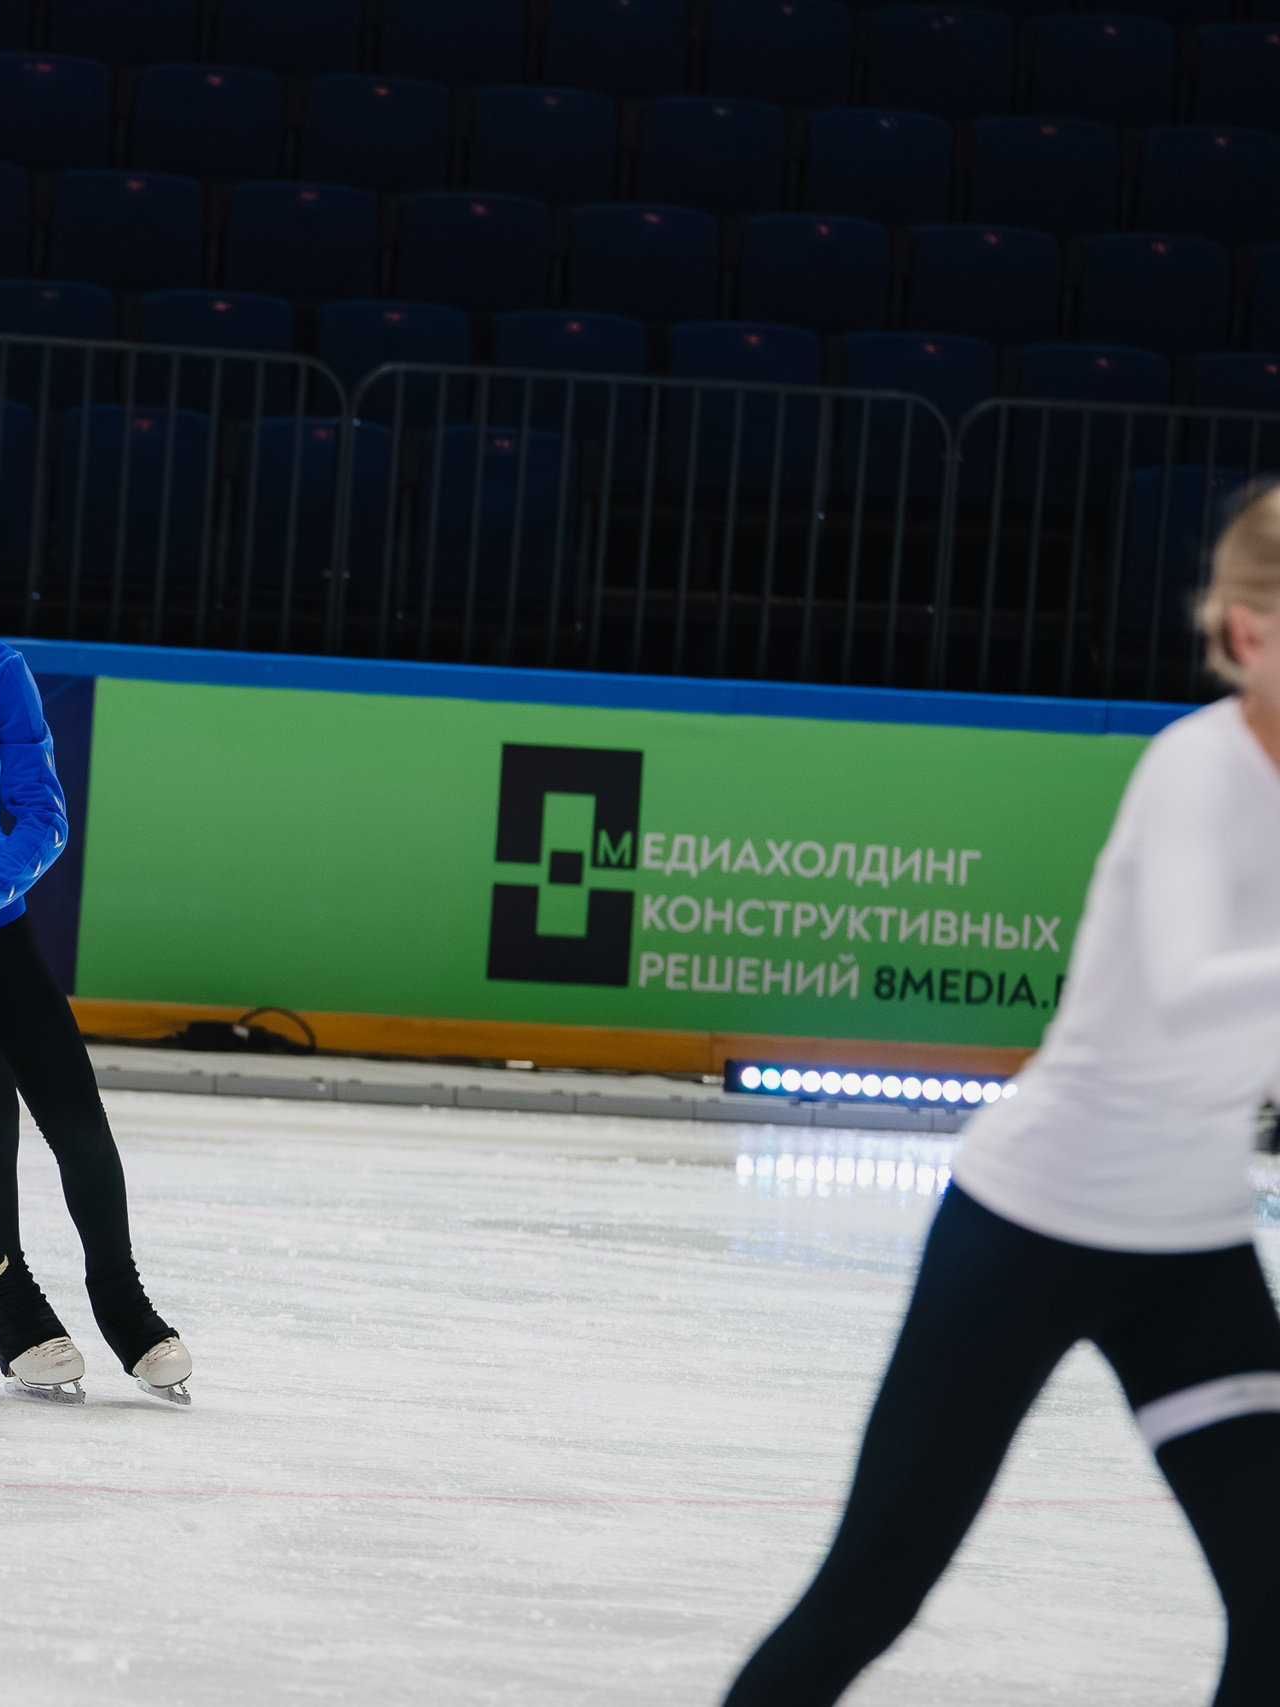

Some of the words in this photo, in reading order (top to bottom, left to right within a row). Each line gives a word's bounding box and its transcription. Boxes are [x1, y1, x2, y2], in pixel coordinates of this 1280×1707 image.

[597, 828, 982, 889] МЕДИАХОЛДИНГ
[641, 893, 1062, 953] КОНСТРУКТИВНЫХ
[637, 951, 861, 1000] РЕШЕНИЙ
